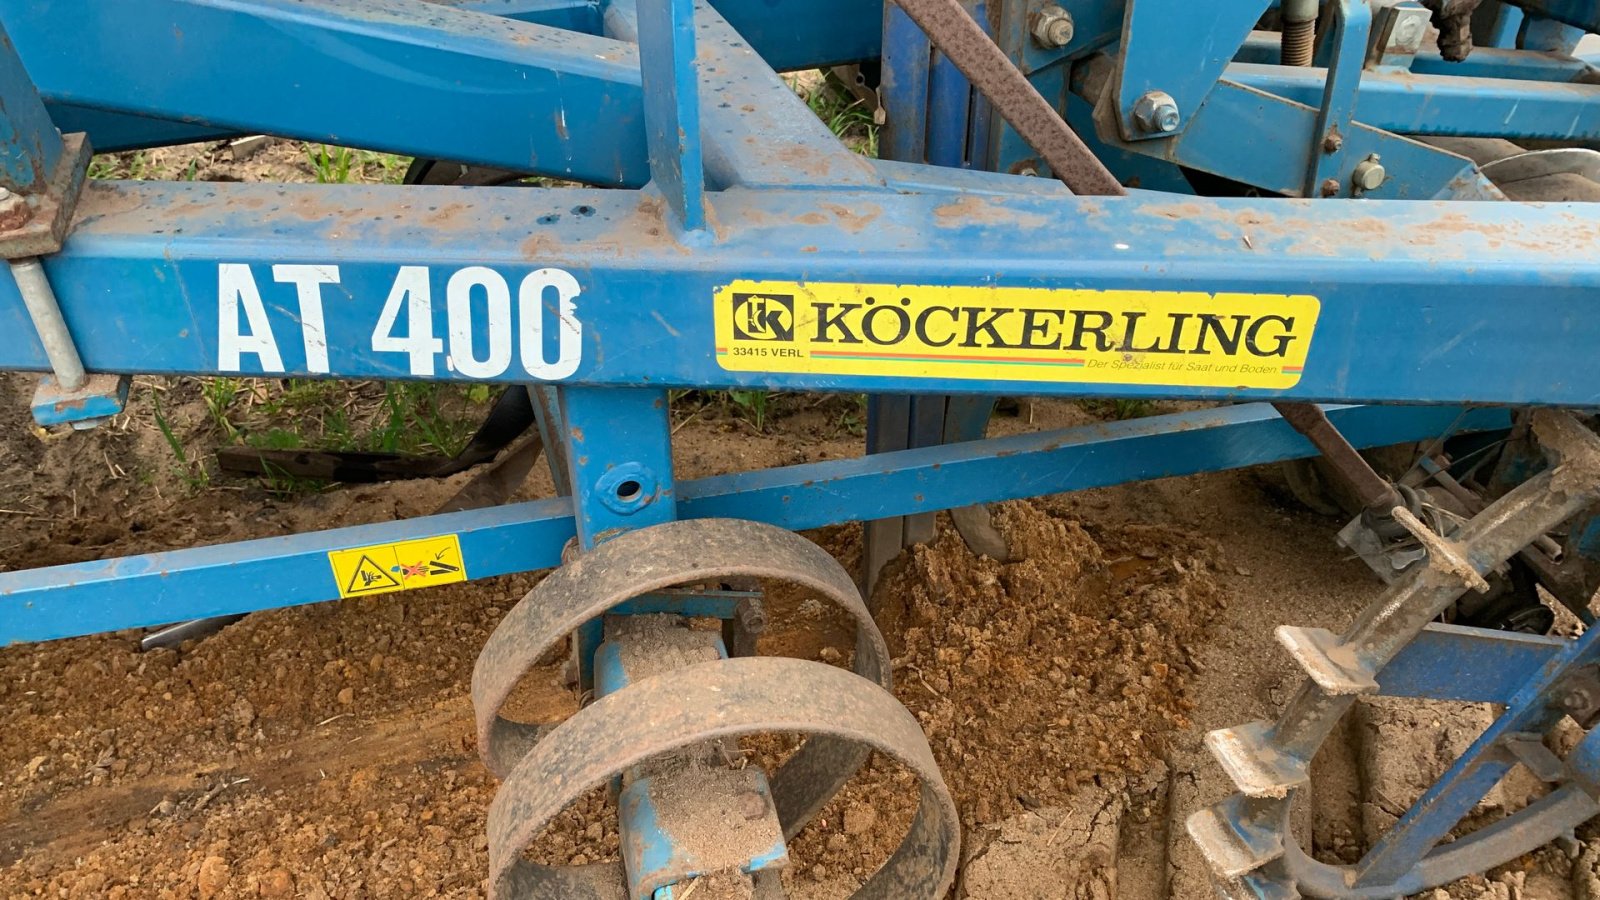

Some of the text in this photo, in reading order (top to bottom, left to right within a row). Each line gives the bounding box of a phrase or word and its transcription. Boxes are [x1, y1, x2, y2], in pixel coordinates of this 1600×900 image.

[218, 263, 582, 380] AT 400
[810, 296, 1297, 358] KÖCKERLING
[733, 347, 804, 358] 33415 VERL
[1087, 359, 1277, 374] Der Spezialist für Saat und Boden
